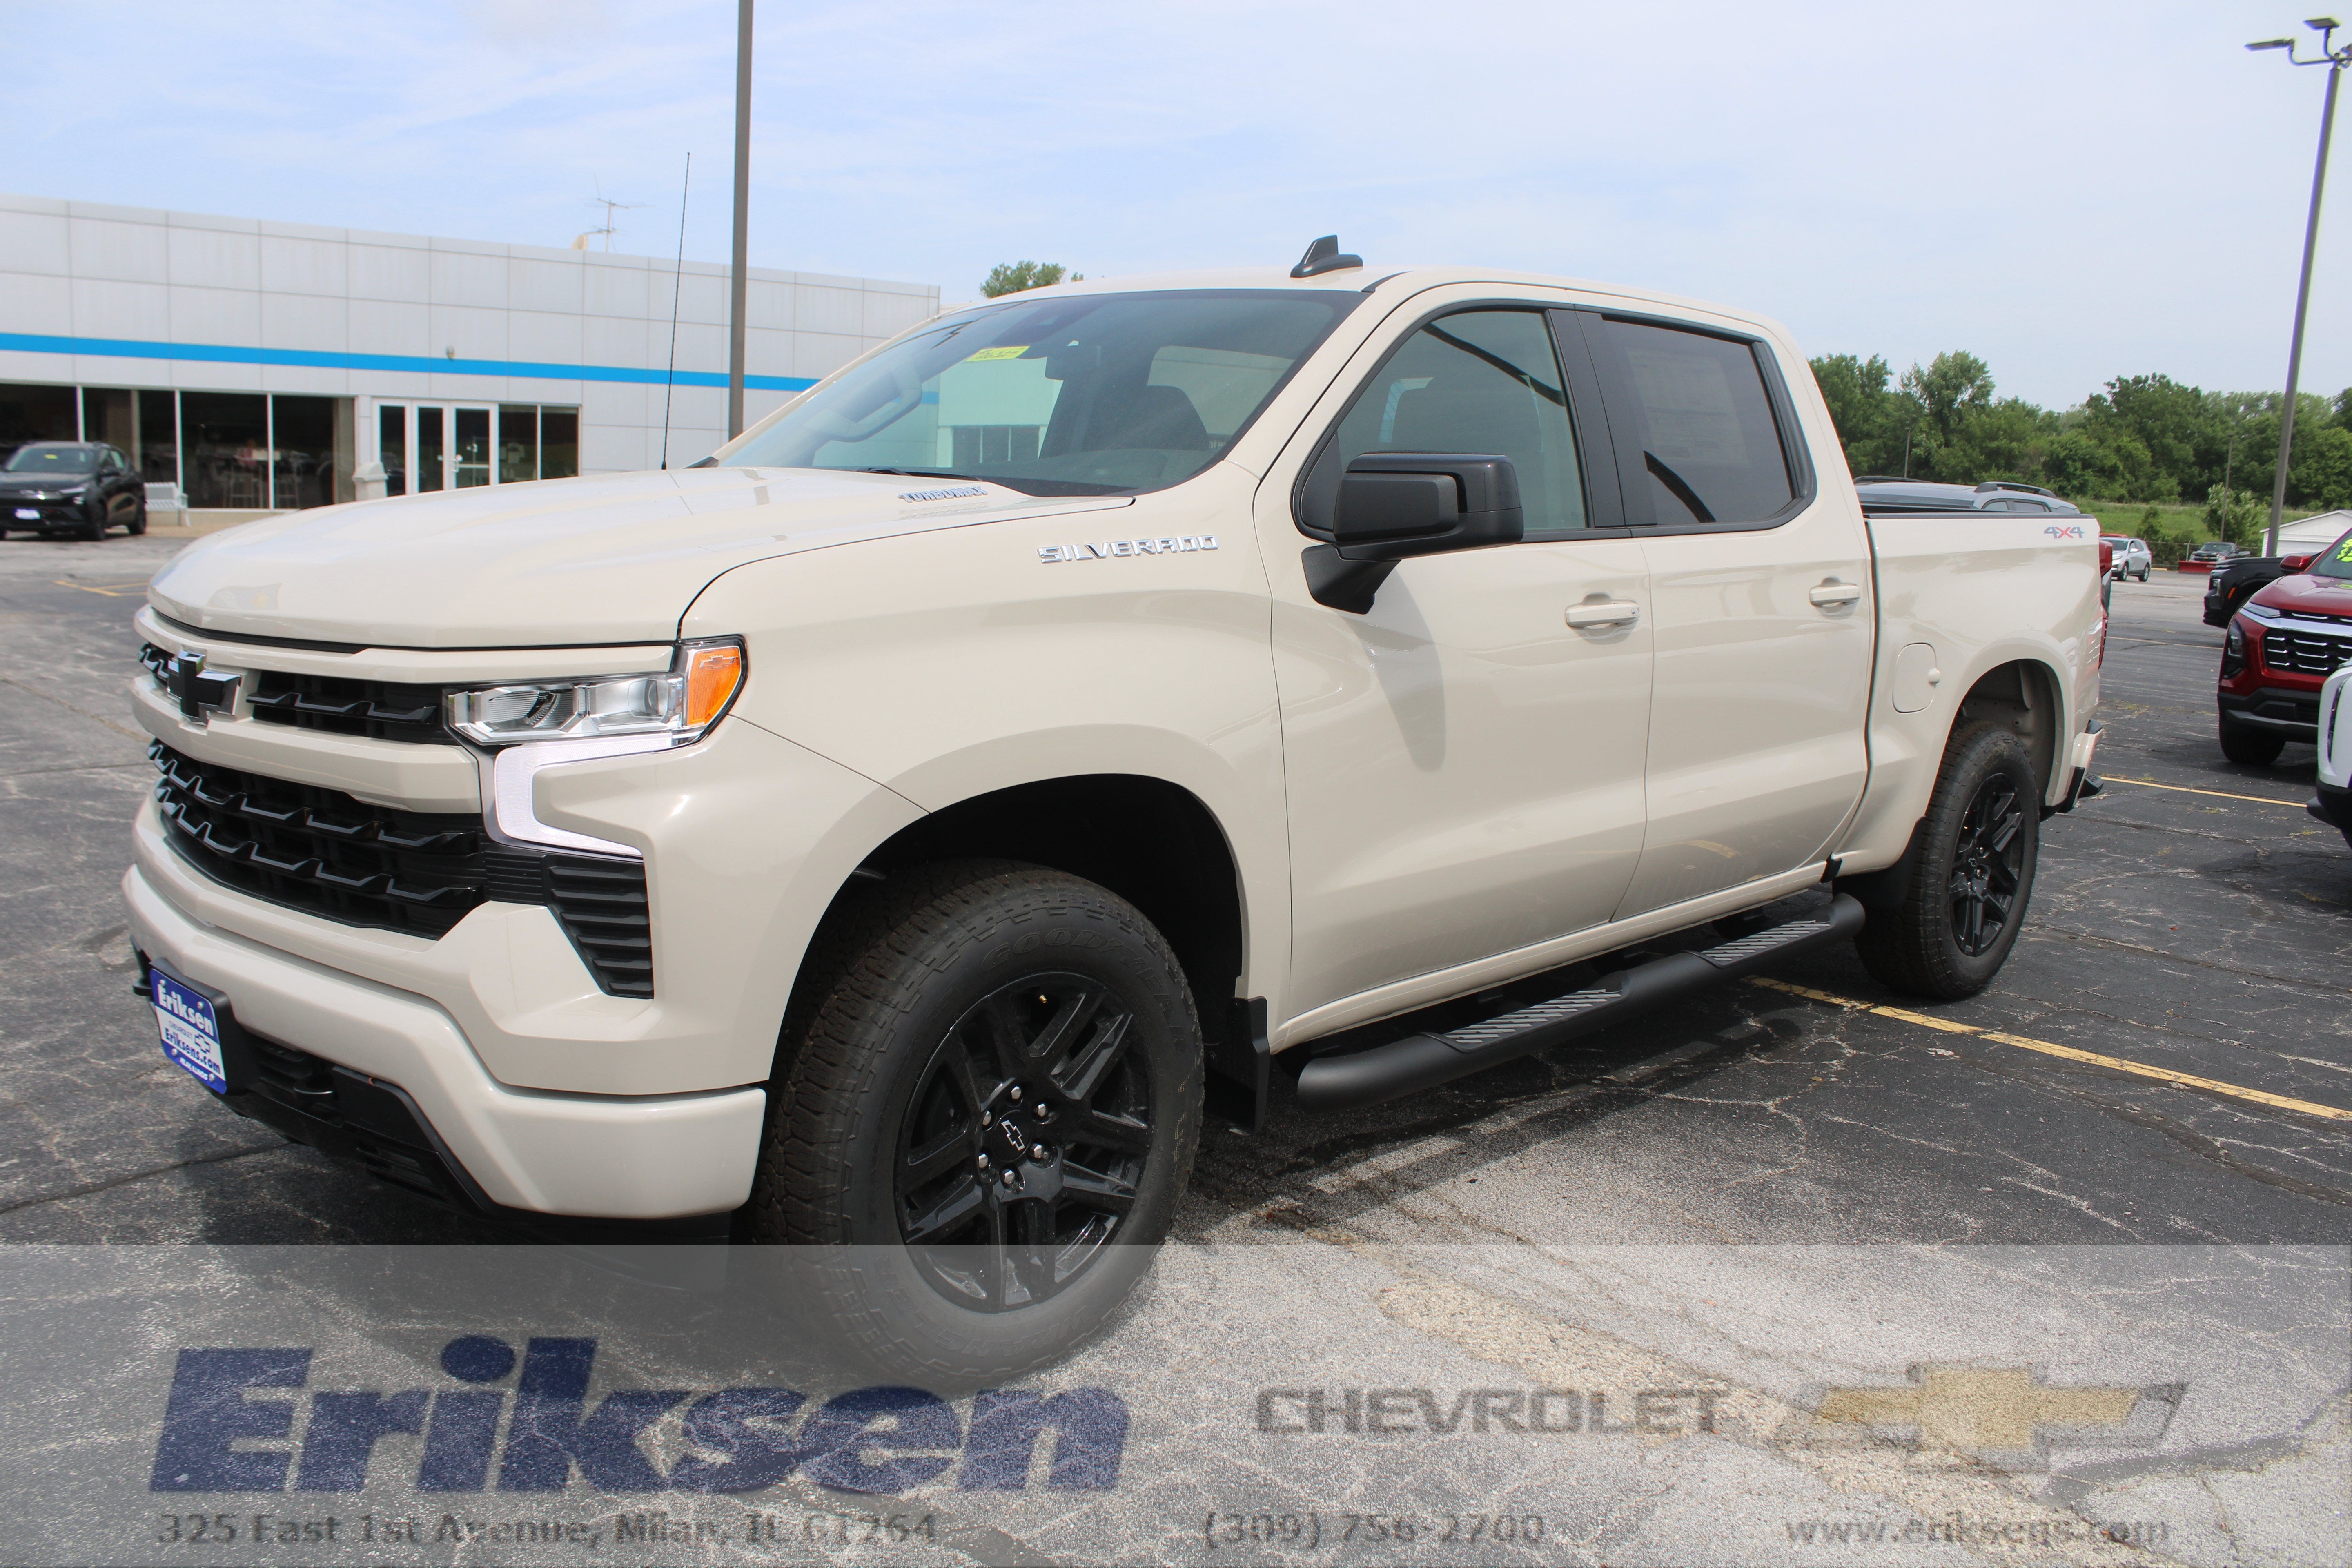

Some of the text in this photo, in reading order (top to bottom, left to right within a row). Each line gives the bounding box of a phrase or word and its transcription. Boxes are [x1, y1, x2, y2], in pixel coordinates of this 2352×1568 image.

[897, 486, 988, 503] TURBOMAX
[1036, 535, 1219, 564] SILVERADO
[157, 983, 214, 1036] Eriksen
[981, 928, 1187, 1054] GOODYEAR
[164, 1027, 220, 1074] Eriksens.com
[875, 1255, 1095, 1358] WRANGLER
